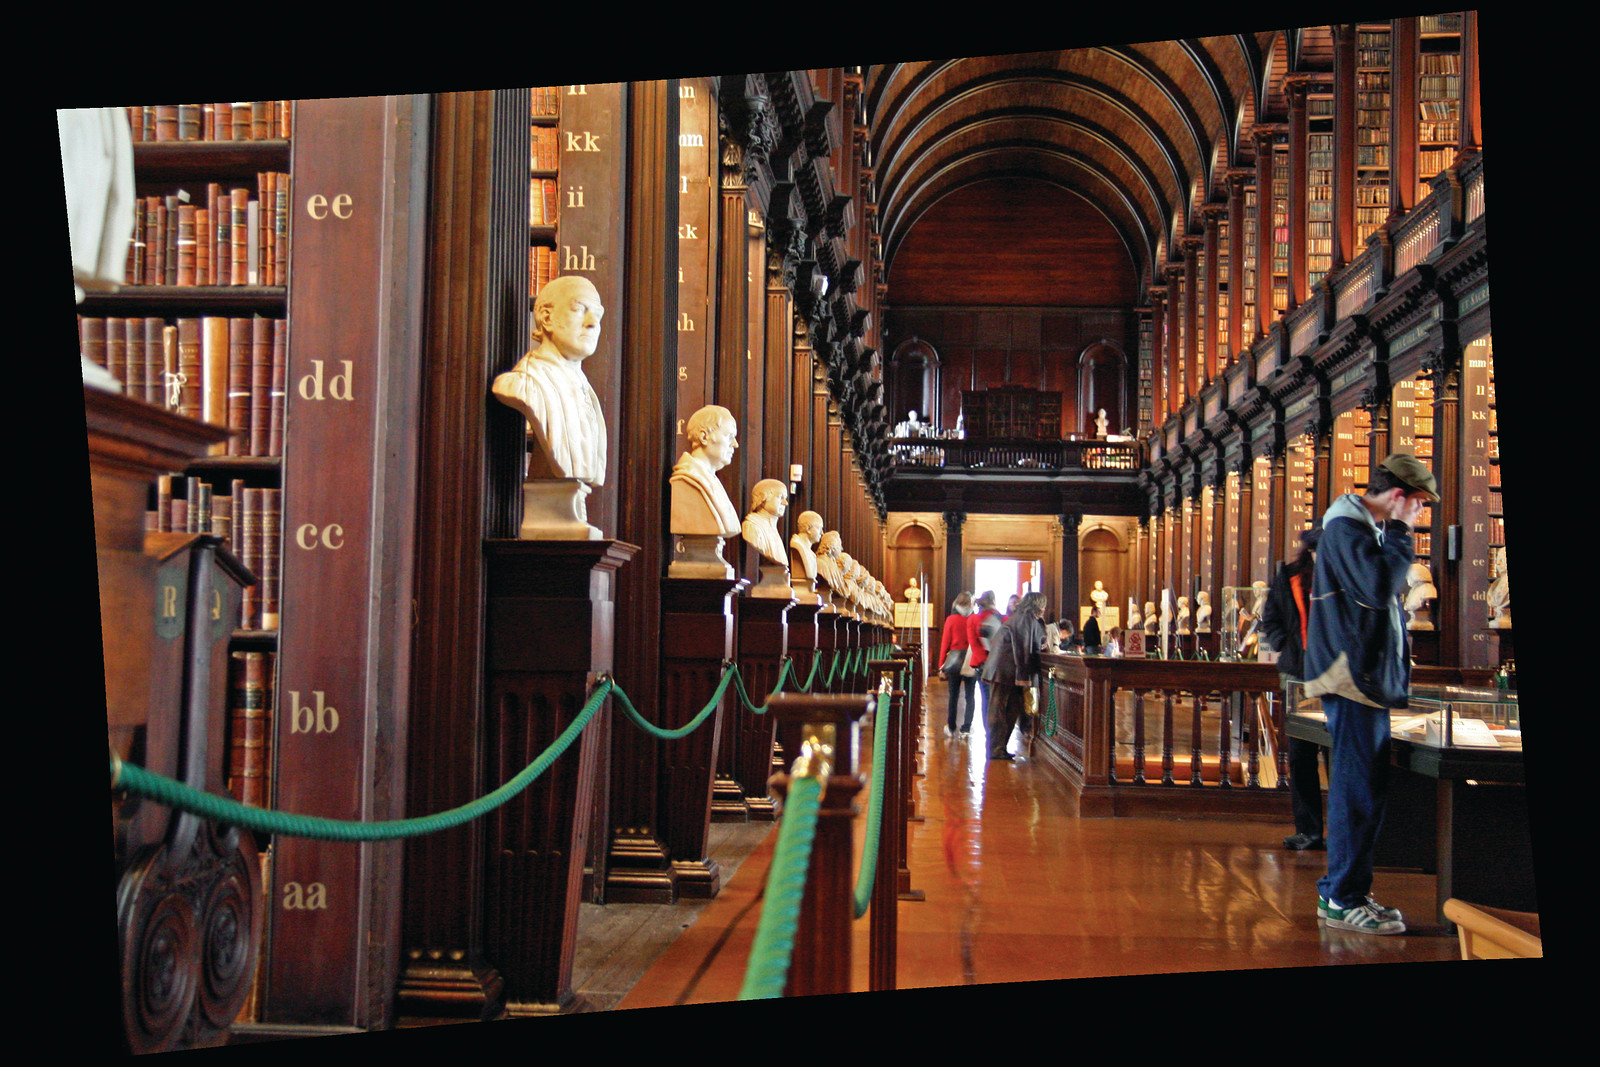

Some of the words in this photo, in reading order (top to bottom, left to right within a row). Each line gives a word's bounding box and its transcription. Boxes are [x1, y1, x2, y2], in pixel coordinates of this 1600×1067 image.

[565, 131, 601, 152] kk
[680, 176, 688, 194] l
[566, 186, 585, 208] ii
[306, 194, 354, 220] ee
[562, 245, 597, 271] hh
[1468, 360, 1487, 368] mm
[298, 360, 354, 401] dd
[1400, 380, 1414, 388] nn
[1476, 384, 1485, 396] ll
[1396, 400, 1415, 408] mm
[1472, 410, 1487, 420] kk
[1402, 416, 1410, 426] ll
[1400, 436, 1414, 446] kk
[1476, 438, 1484, 448] ii
[1342, 468, 1354, 477] kk
[1471, 466, 1487, 476] hh
[1474, 522, 1484, 532] ff
[296, 523, 345, 550] cc
[1472, 558, 1486, 566] ee
[1472, 590, 1486, 600] dd
[163, 586, 178, 618] R
[288, 690, 340, 734] bb
[282, 882, 328, 911] aa
